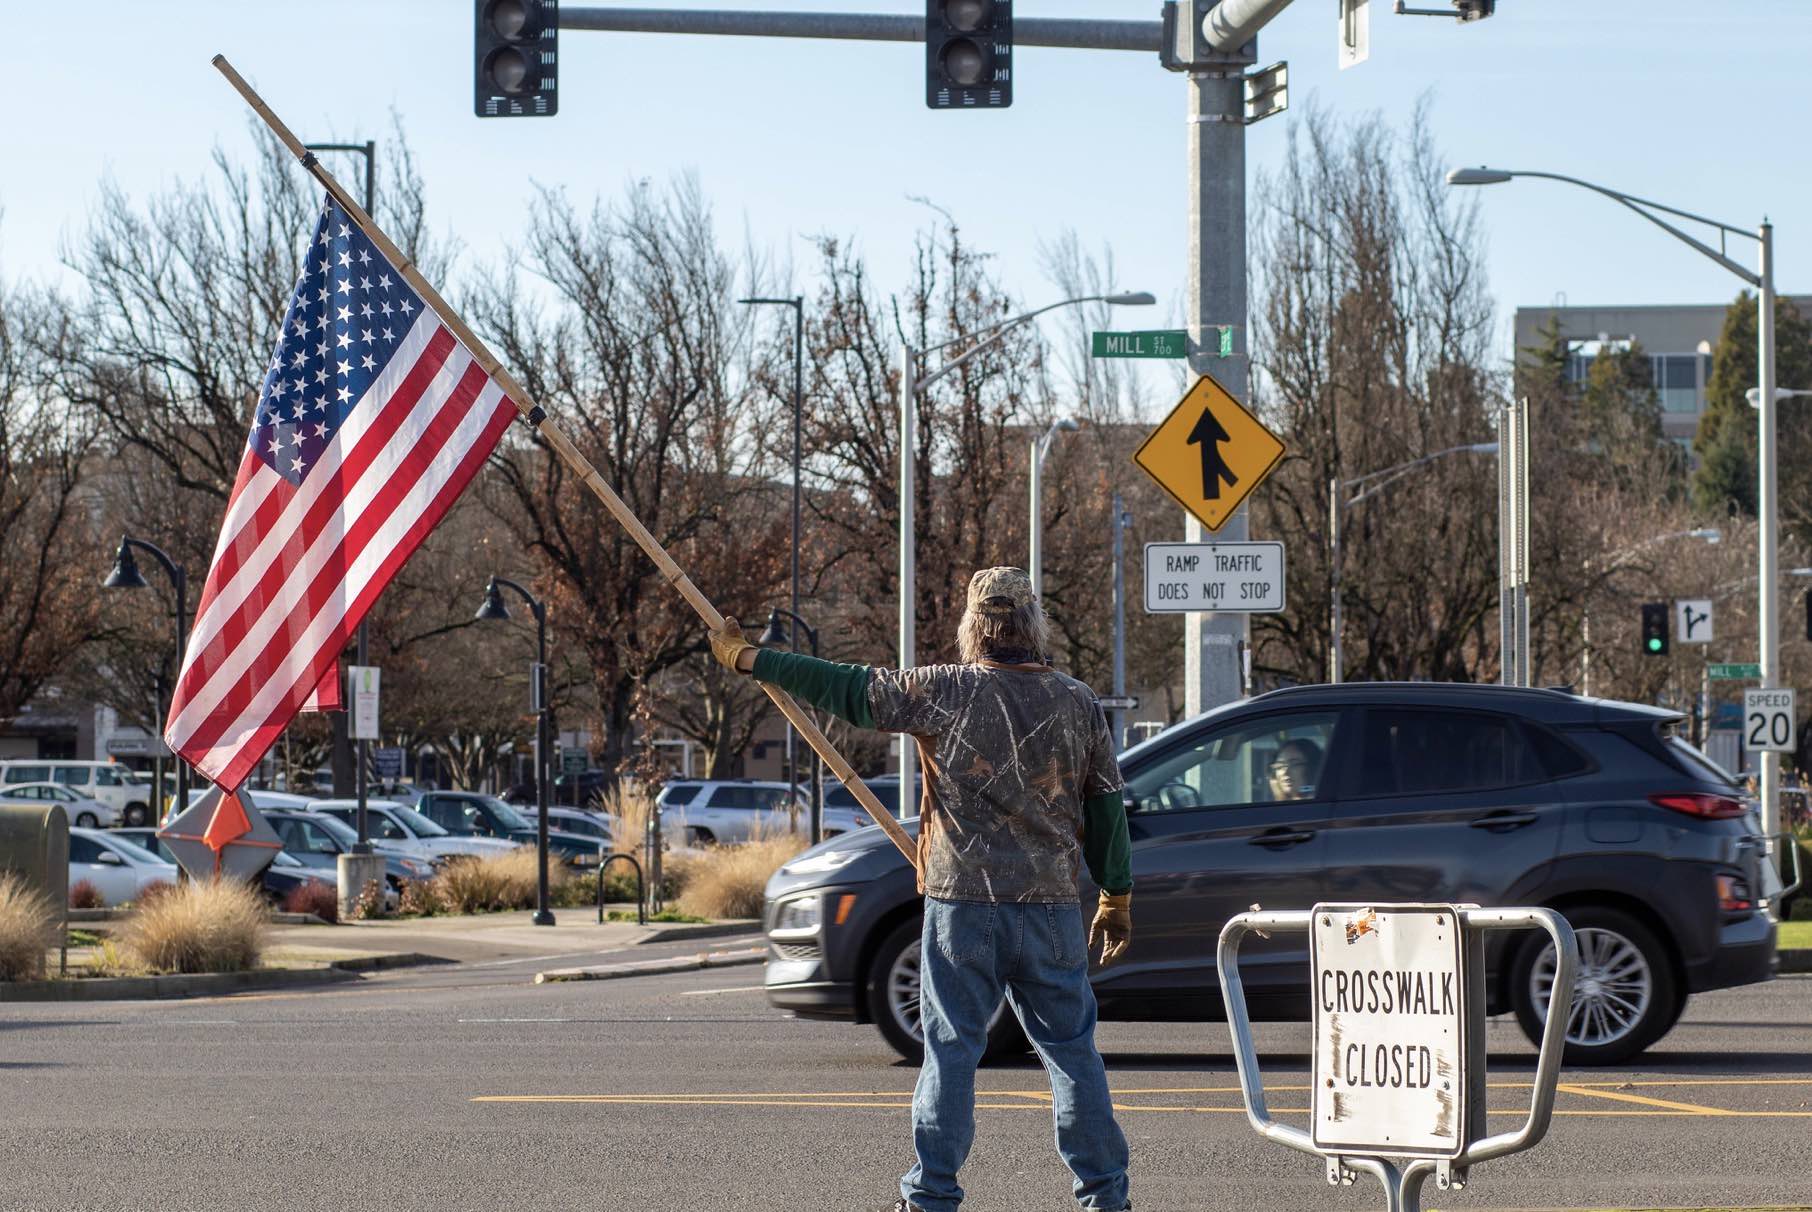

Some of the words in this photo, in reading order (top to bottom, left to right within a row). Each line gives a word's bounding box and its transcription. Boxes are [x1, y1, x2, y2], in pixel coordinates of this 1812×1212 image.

[1106, 336, 1145, 354] MILL
[1153, 336, 1164, 345] ST
[1153, 346, 1172, 355] 700
[1166, 555, 1200, 572] RAMP
[1214, 555, 1263, 572] TRAFFIC
[1158, 583, 1189, 600] DOES
[1203, 582, 1226, 599] NOT
[1240, 582, 1271, 599] STOP
[1748, 694, 1791, 707] SPEED
[1748, 712, 1790, 746] 20
[1321, 969, 1455, 1015] CROSSWALK
[1346, 1043, 1431, 1089] CLOSED
